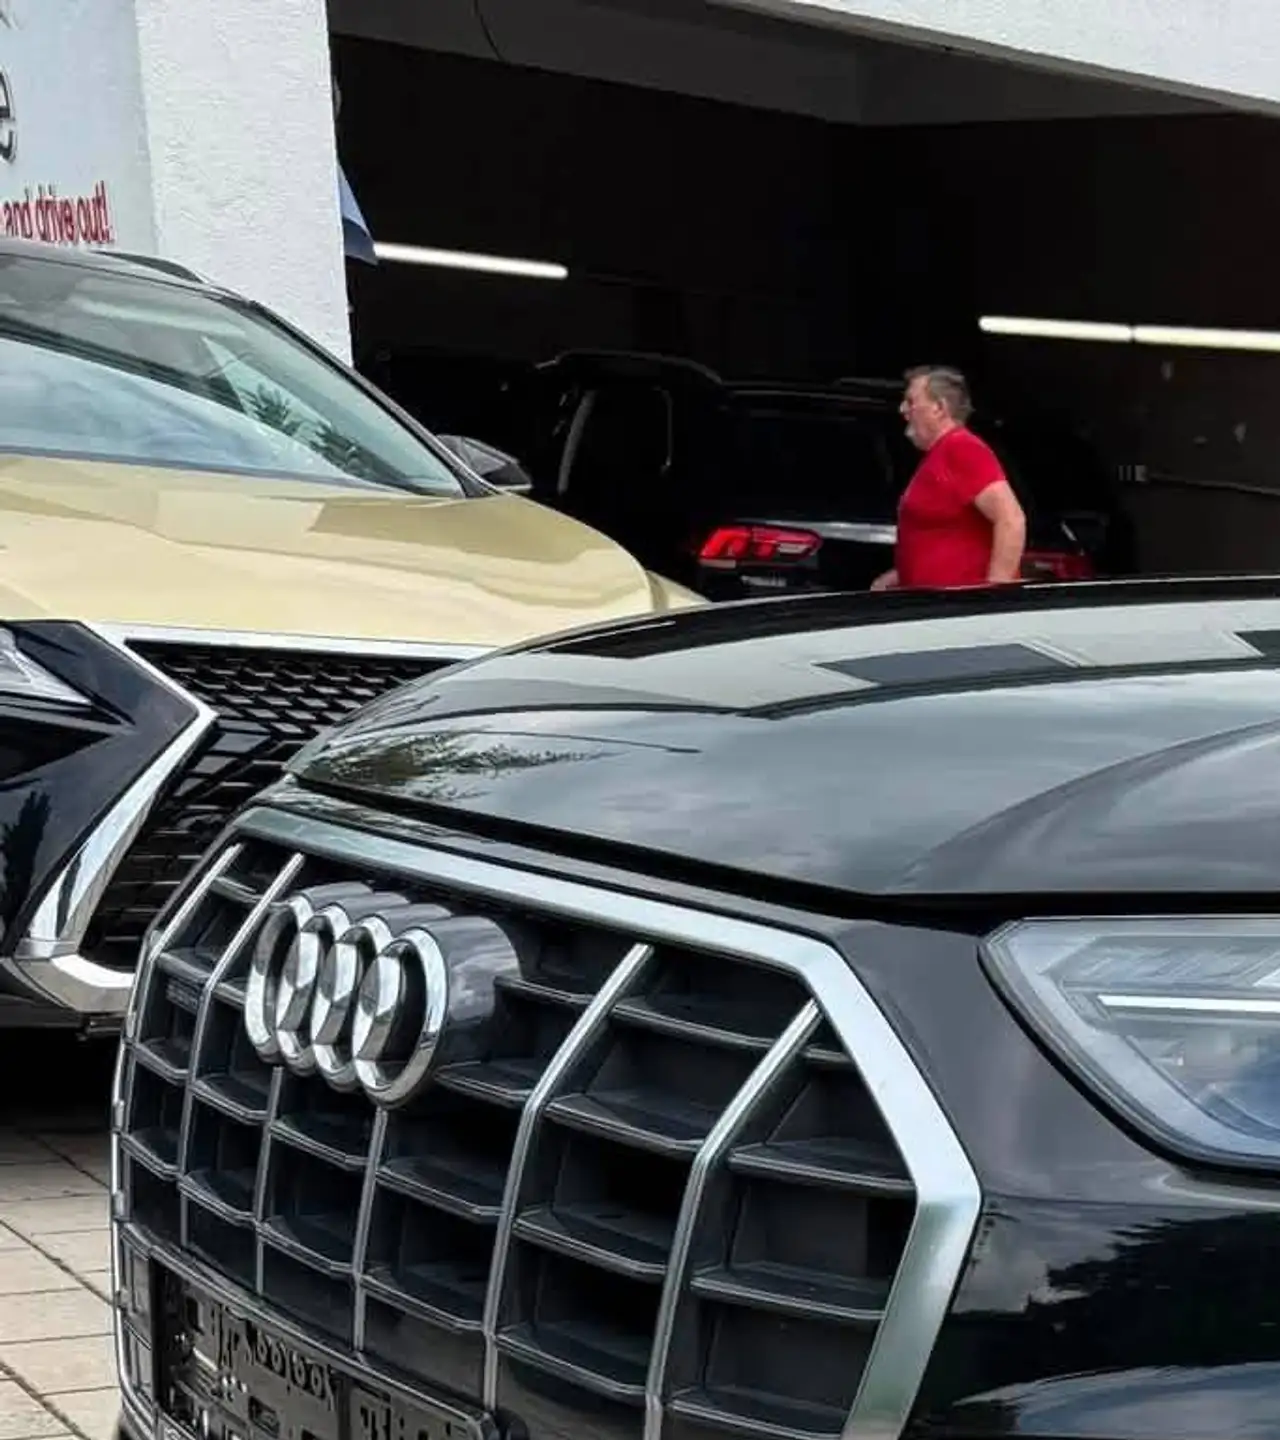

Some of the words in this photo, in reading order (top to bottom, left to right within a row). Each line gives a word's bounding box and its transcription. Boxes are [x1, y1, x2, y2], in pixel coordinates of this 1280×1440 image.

[3, 187, 33, 239] and
[35, 183, 76, 245] drive
[76, 180, 111, 244] out!
